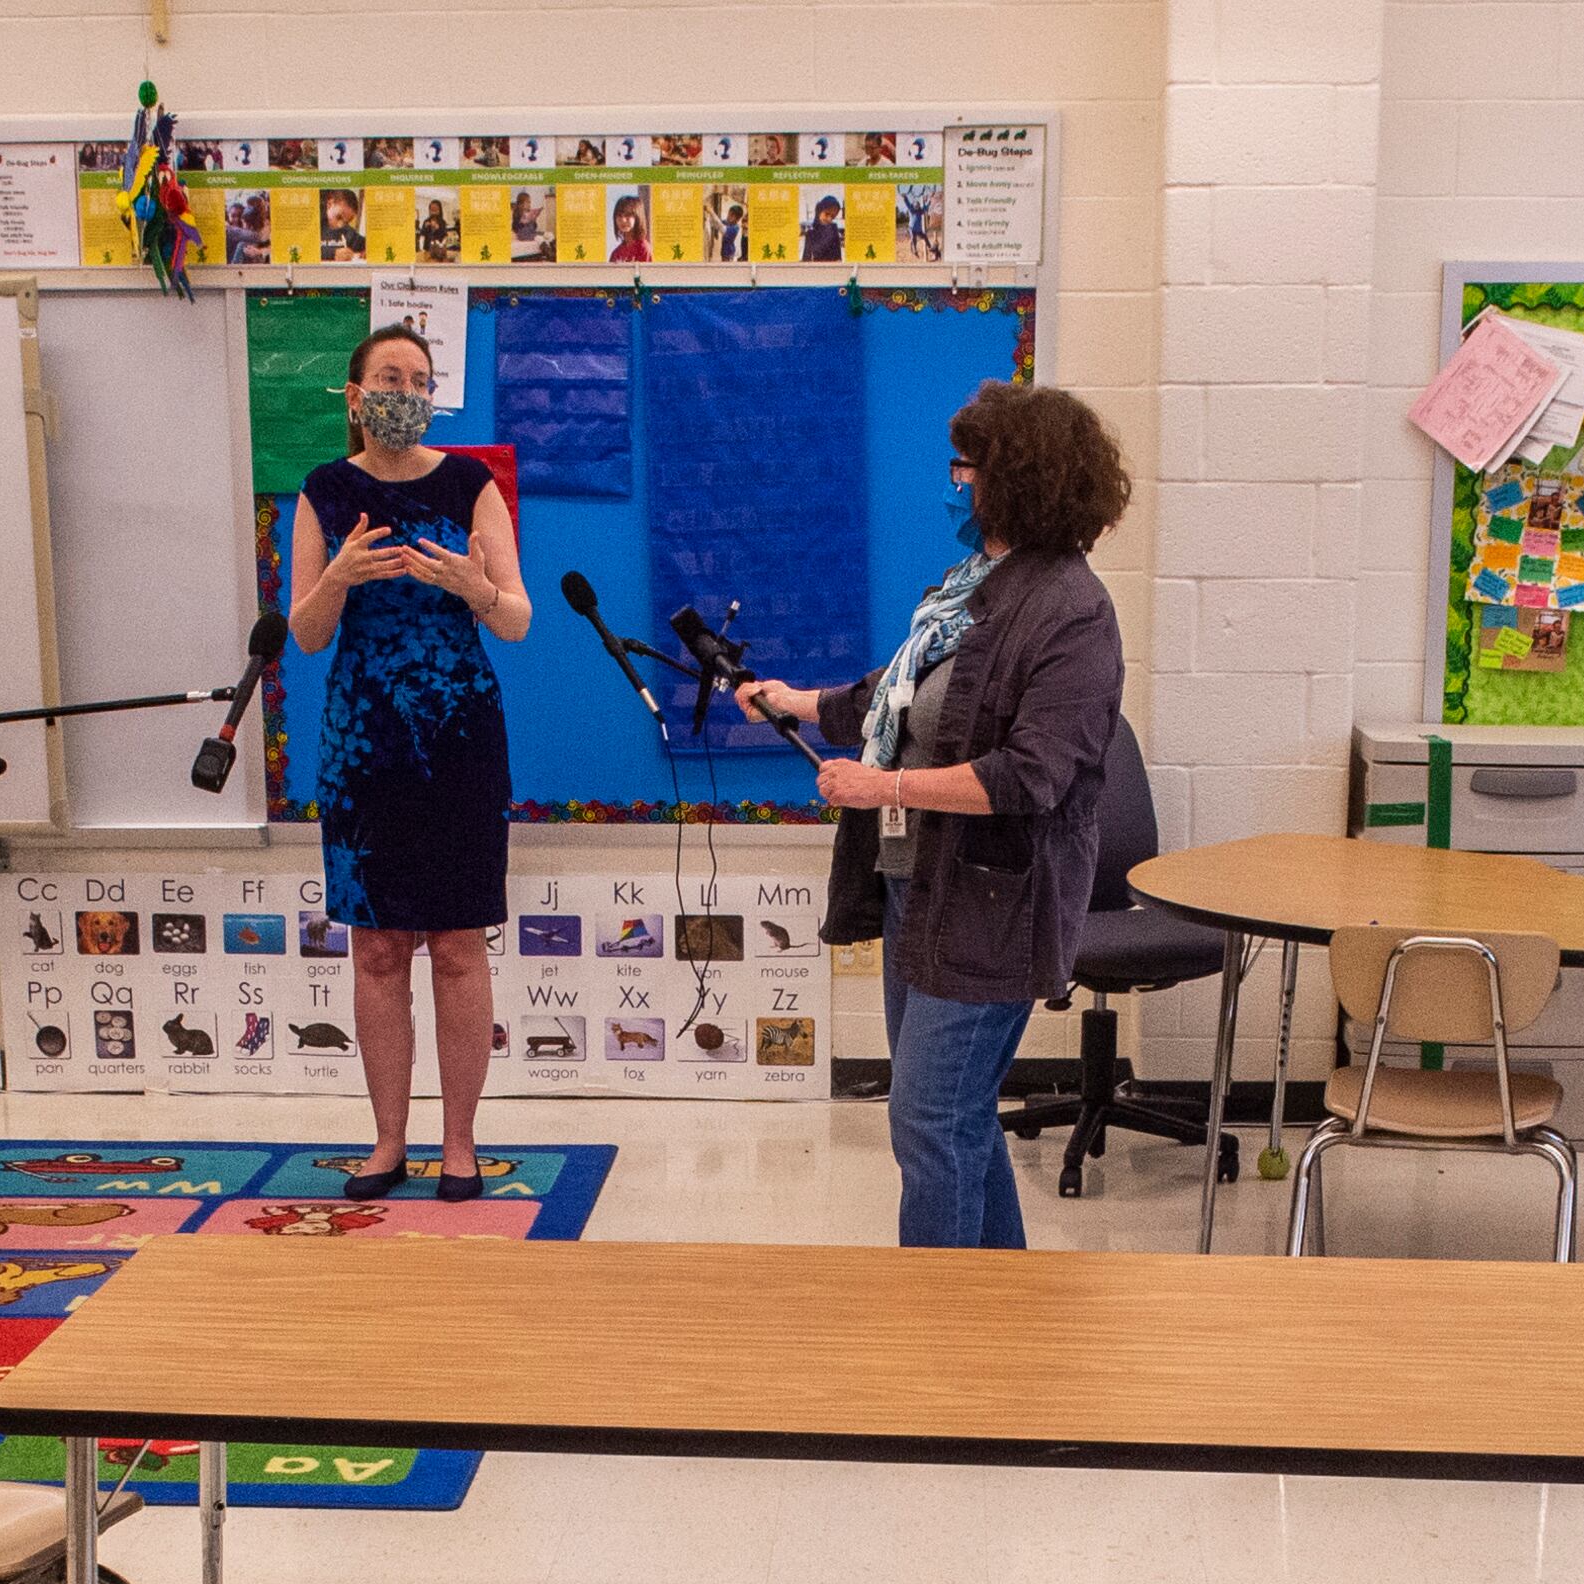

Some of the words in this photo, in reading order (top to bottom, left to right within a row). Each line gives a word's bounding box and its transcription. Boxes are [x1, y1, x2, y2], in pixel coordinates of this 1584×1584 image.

[958, 147, 998, 158] De-Bug
[1001, 146, 1033, 158] Steps
[206, 175, 238, 184] CARING
[281, 175, 352, 185] COMMUNICATORS
[471, 172, 544, 182] KNOWLEDGEABLE
[773, 171, 820, 180] REFLECTIVE
[397, 281, 438, 293] Claroom
[439, 285, 459, 294] Rules
[388, 299, 405, 309] Safe
[406, 301, 433, 310] bodies
[17, 878, 59, 902] Cc
[85, 880, 126, 903] Dd
[162, 880, 195, 903] Ee
[242, 880, 265, 903] Ff
[299, 880, 324, 904] G
[540, 882, 559, 911] Jj
[615, 882, 645, 905] Kk
[700, 883, 718, 907] Ll
[757, 883, 812, 906] Mm
[31, 960, 55, 973] cat
[94, 961, 124, 976] dog
[162, 963, 198, 976] eggs
[244, 961, 266, 975] fish
[307, 962, 341, 978] goat
[541, 963, 559, 978] jet
[616, 963, 642, 977] kite
[760, 965, 809, 979] mouse
[27, 982, 63, 1009] Pp
[90, 981, 134, 1009] Qq
[174, 982, 199, 1005] Rr
[238, 982, 264, 1005] Ss
[308, 982, 331, 1007] Tt
[527, 986, 578, 1008] Ww
[619, 986, 650, 1008] Xx
[696, 987, 727, 1014] Yy
[771, 989, 799, 1011] Zz
[36, 1063, 64, 1076] pan
[88, 1062, 146, 1076] quarters
[168, 1061, 210, 1075] rabbit
[233, 1062, 272, 1076] socks
[304, 1064, 339, 1078] turtle
[528, 1067, 579, 1083] wagon
[623, 1066, 646, 1081] fox
[764, 1068, 805, 1082] zebra
[695, 1069, 727, 1083] yarn
[491, 1183, 532, 1195] V
[264, 1456, 395, 1483] Aa
